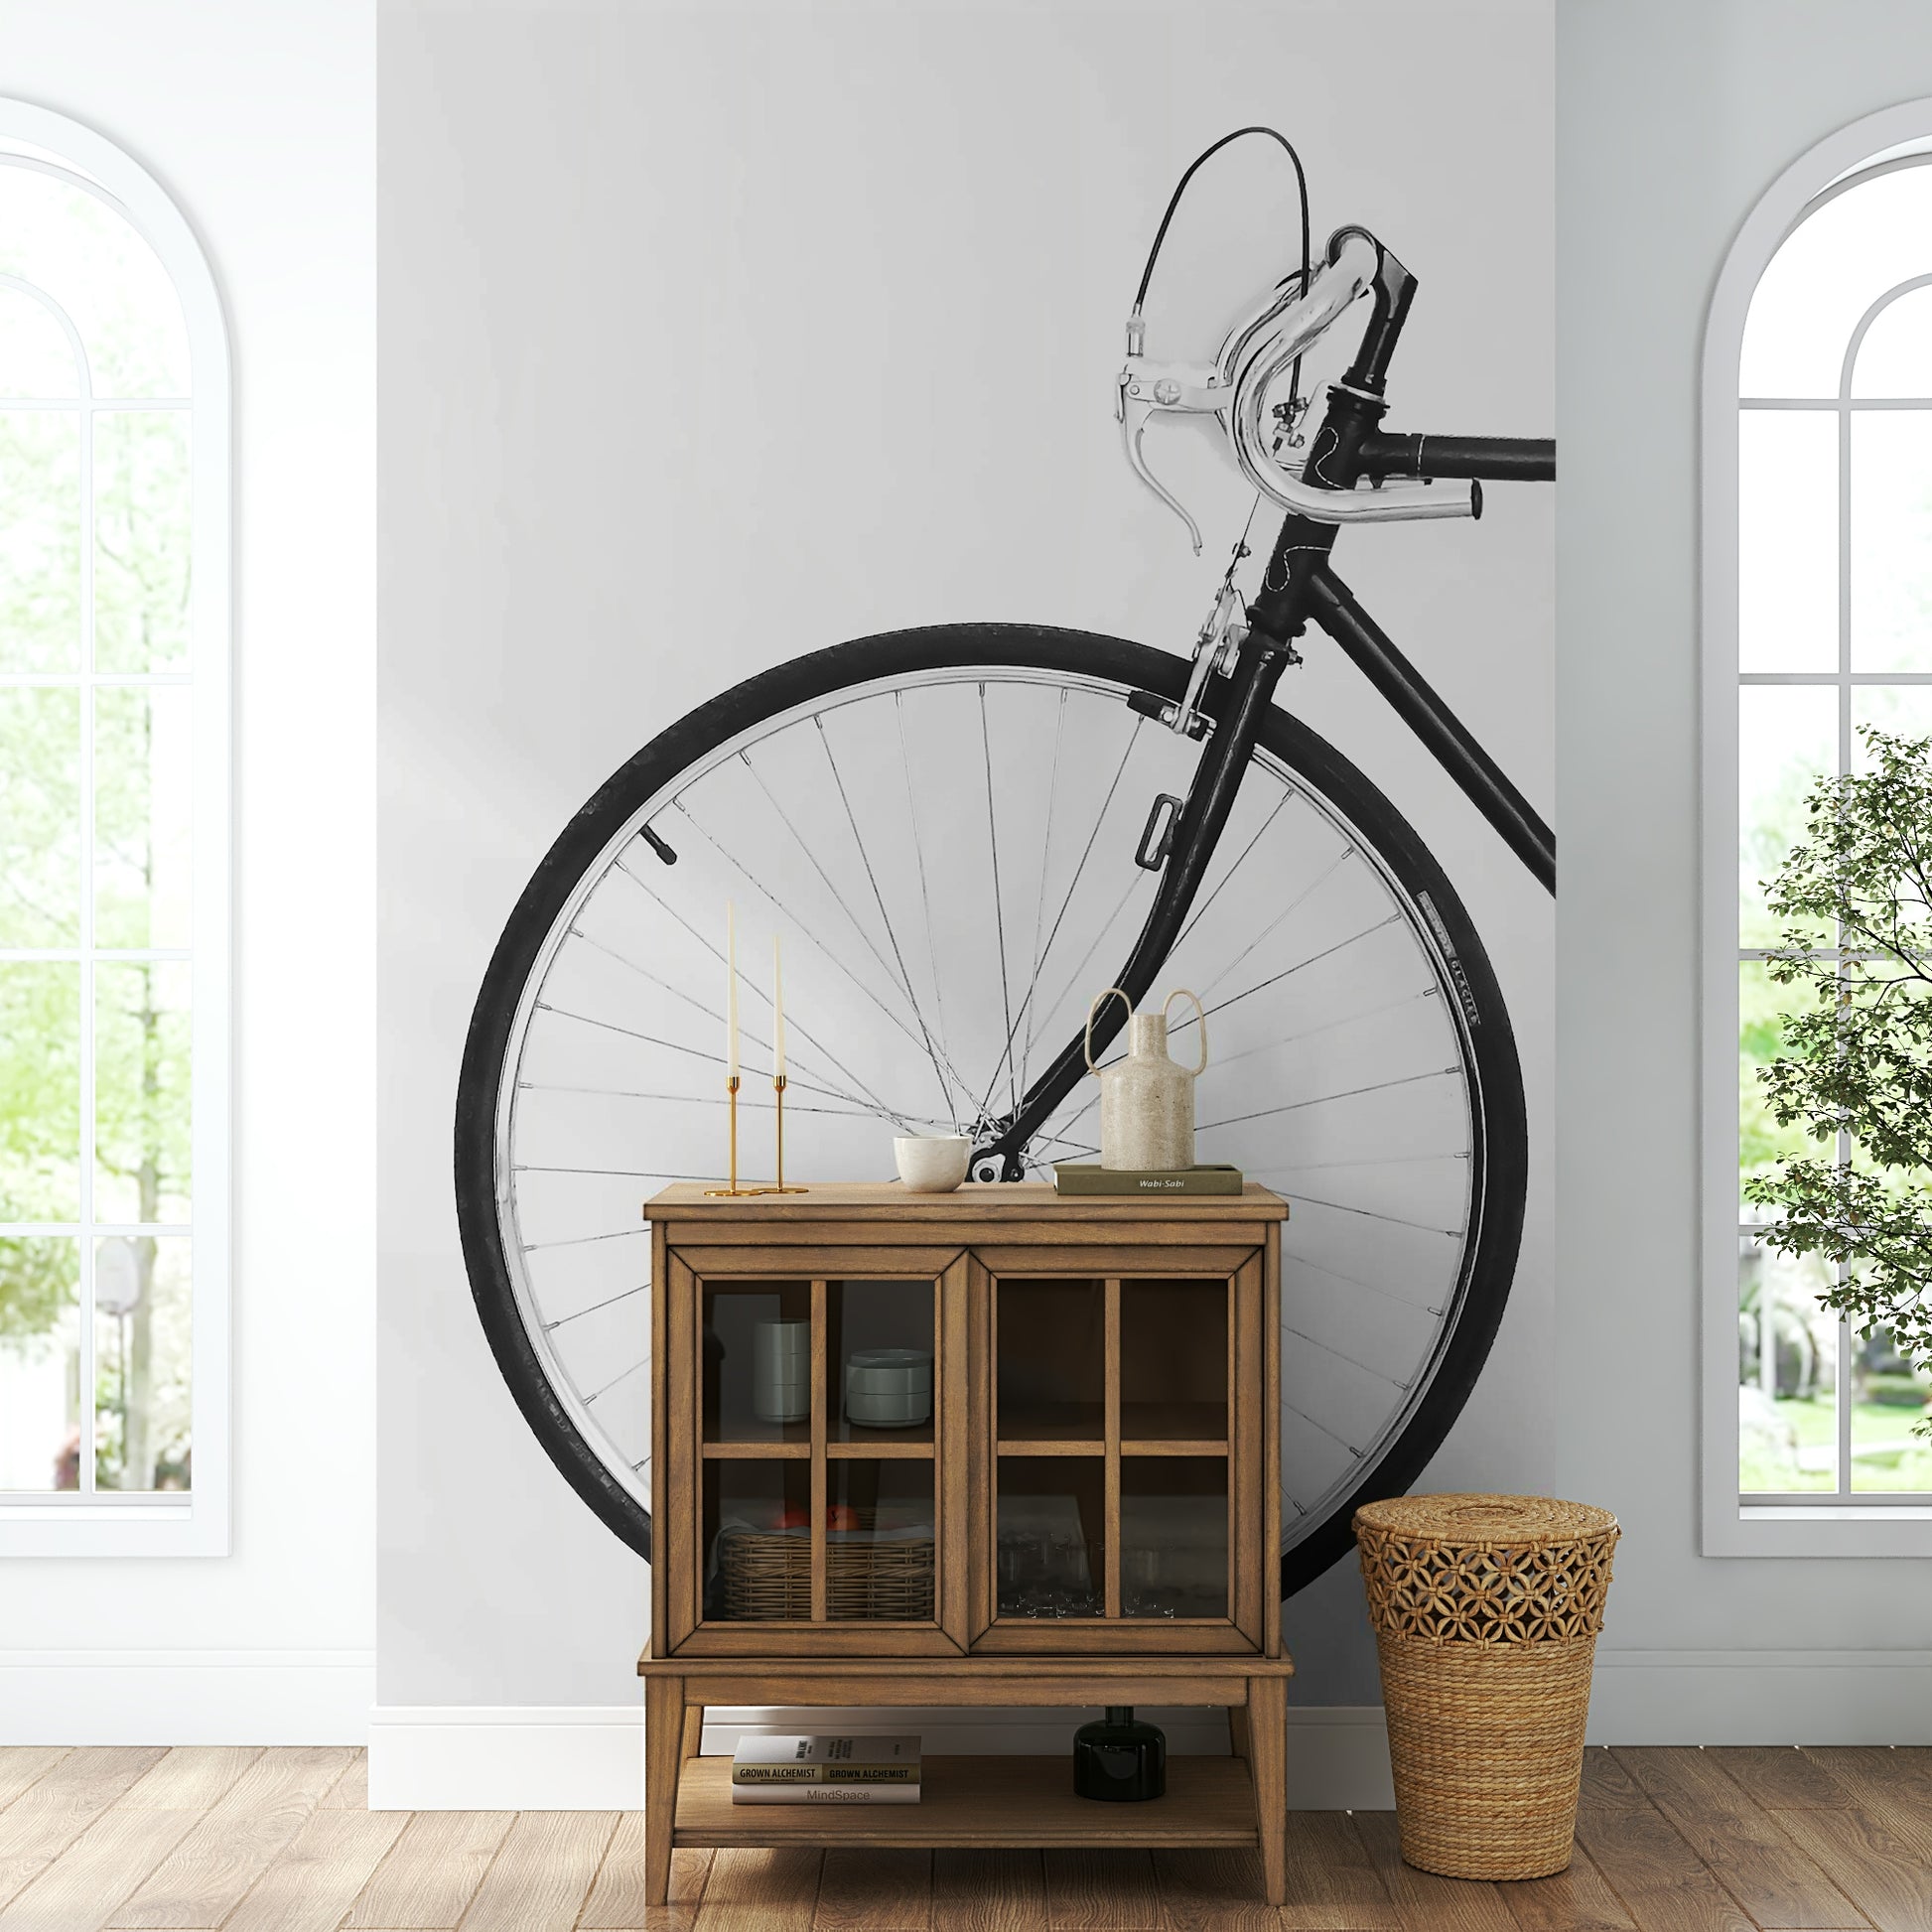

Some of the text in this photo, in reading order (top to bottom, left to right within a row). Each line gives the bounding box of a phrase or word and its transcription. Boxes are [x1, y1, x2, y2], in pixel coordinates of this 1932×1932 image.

[740, 1768, 816, 1778] GROWN ALCHEMIST
[829, 1769, 909, 1779] GROWN ALCHEMIST
[806, 1789, 871, 1801] MindSpace
